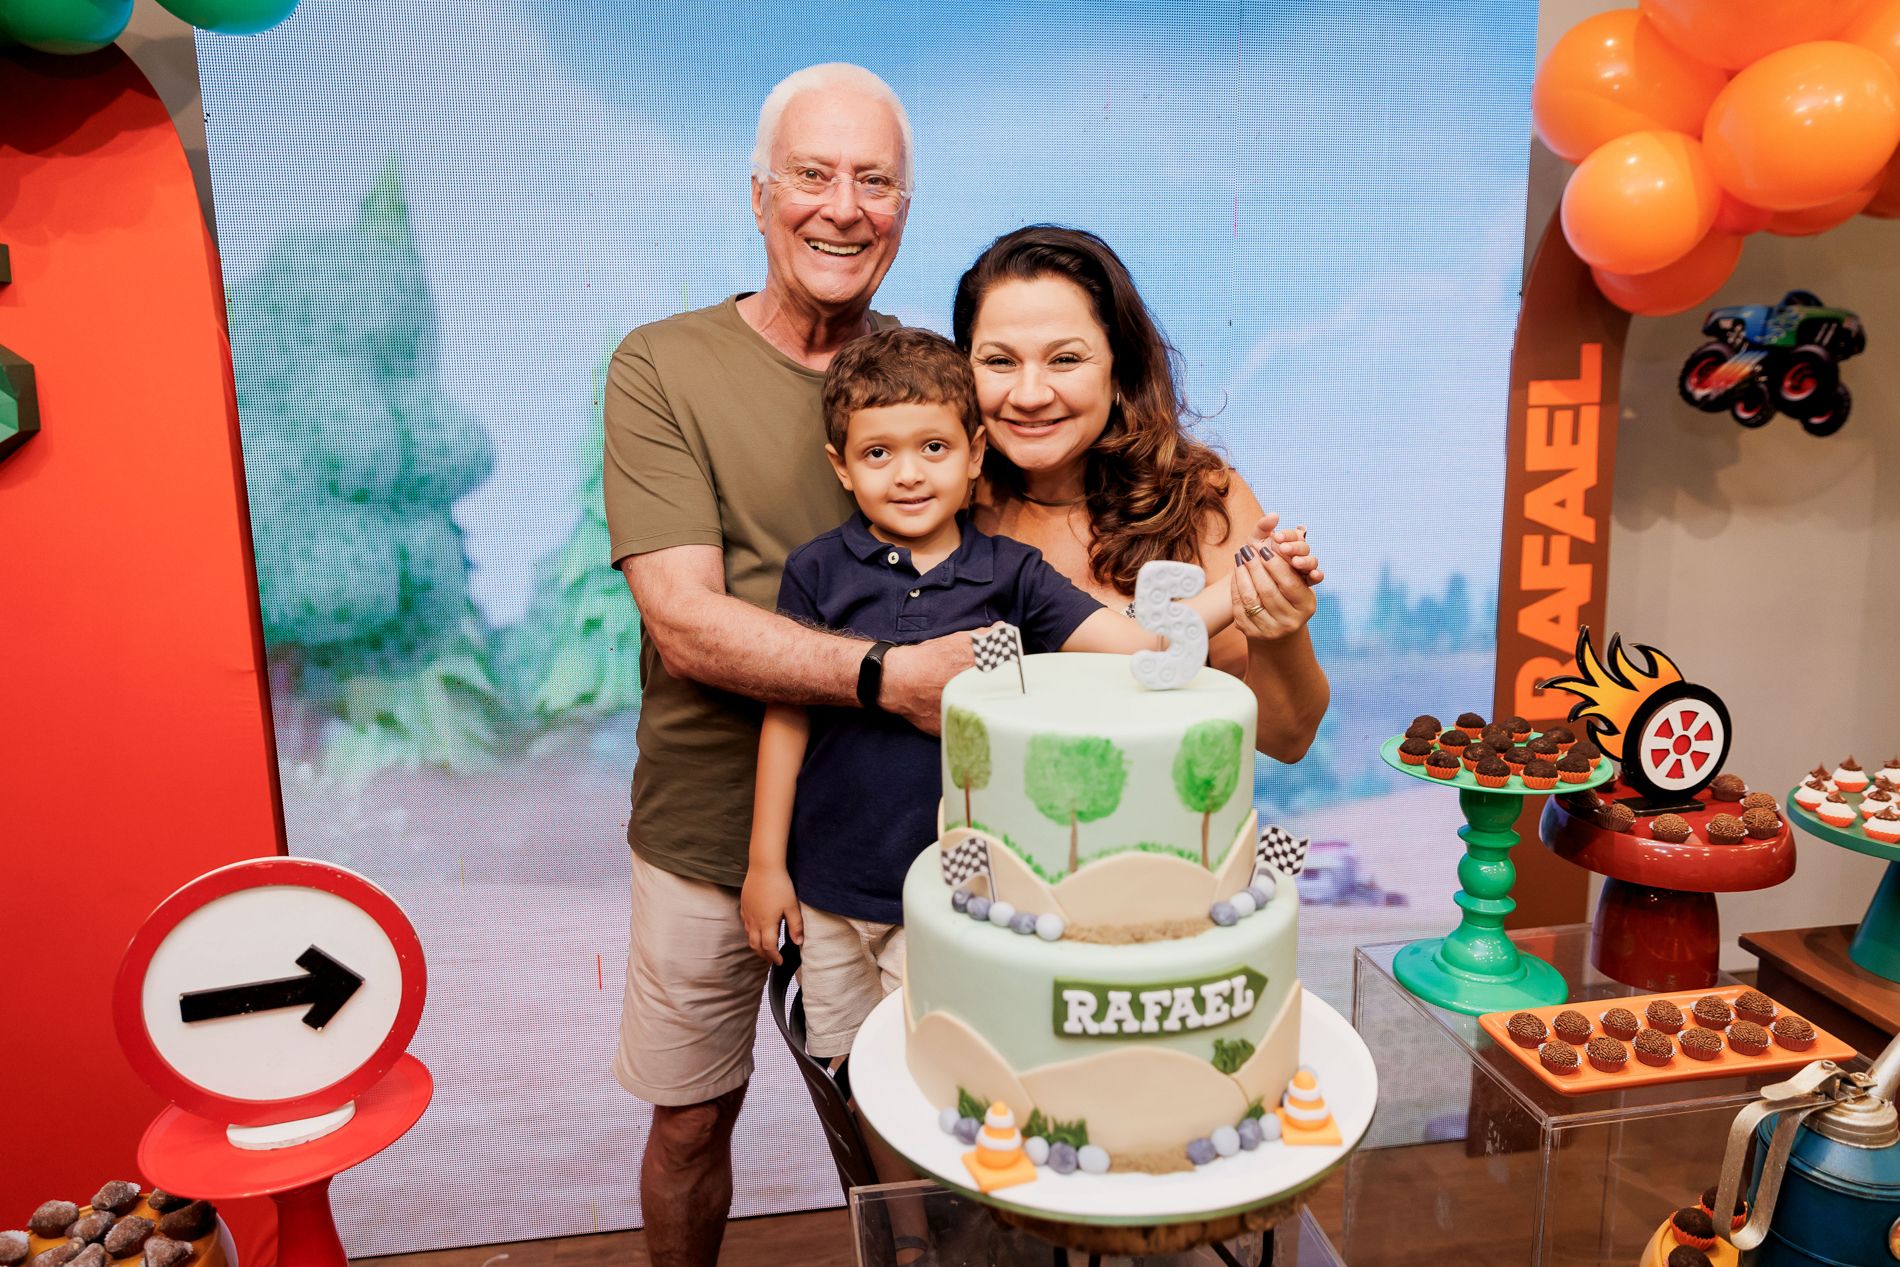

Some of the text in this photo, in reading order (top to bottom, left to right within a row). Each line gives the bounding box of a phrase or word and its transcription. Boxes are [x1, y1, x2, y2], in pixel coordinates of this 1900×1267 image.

[1514, 343, 1603, 720] RAFAEL
[1130, 560, 1209, 690] 5
[1062, 975, 1254, 1034] RAFAEL
